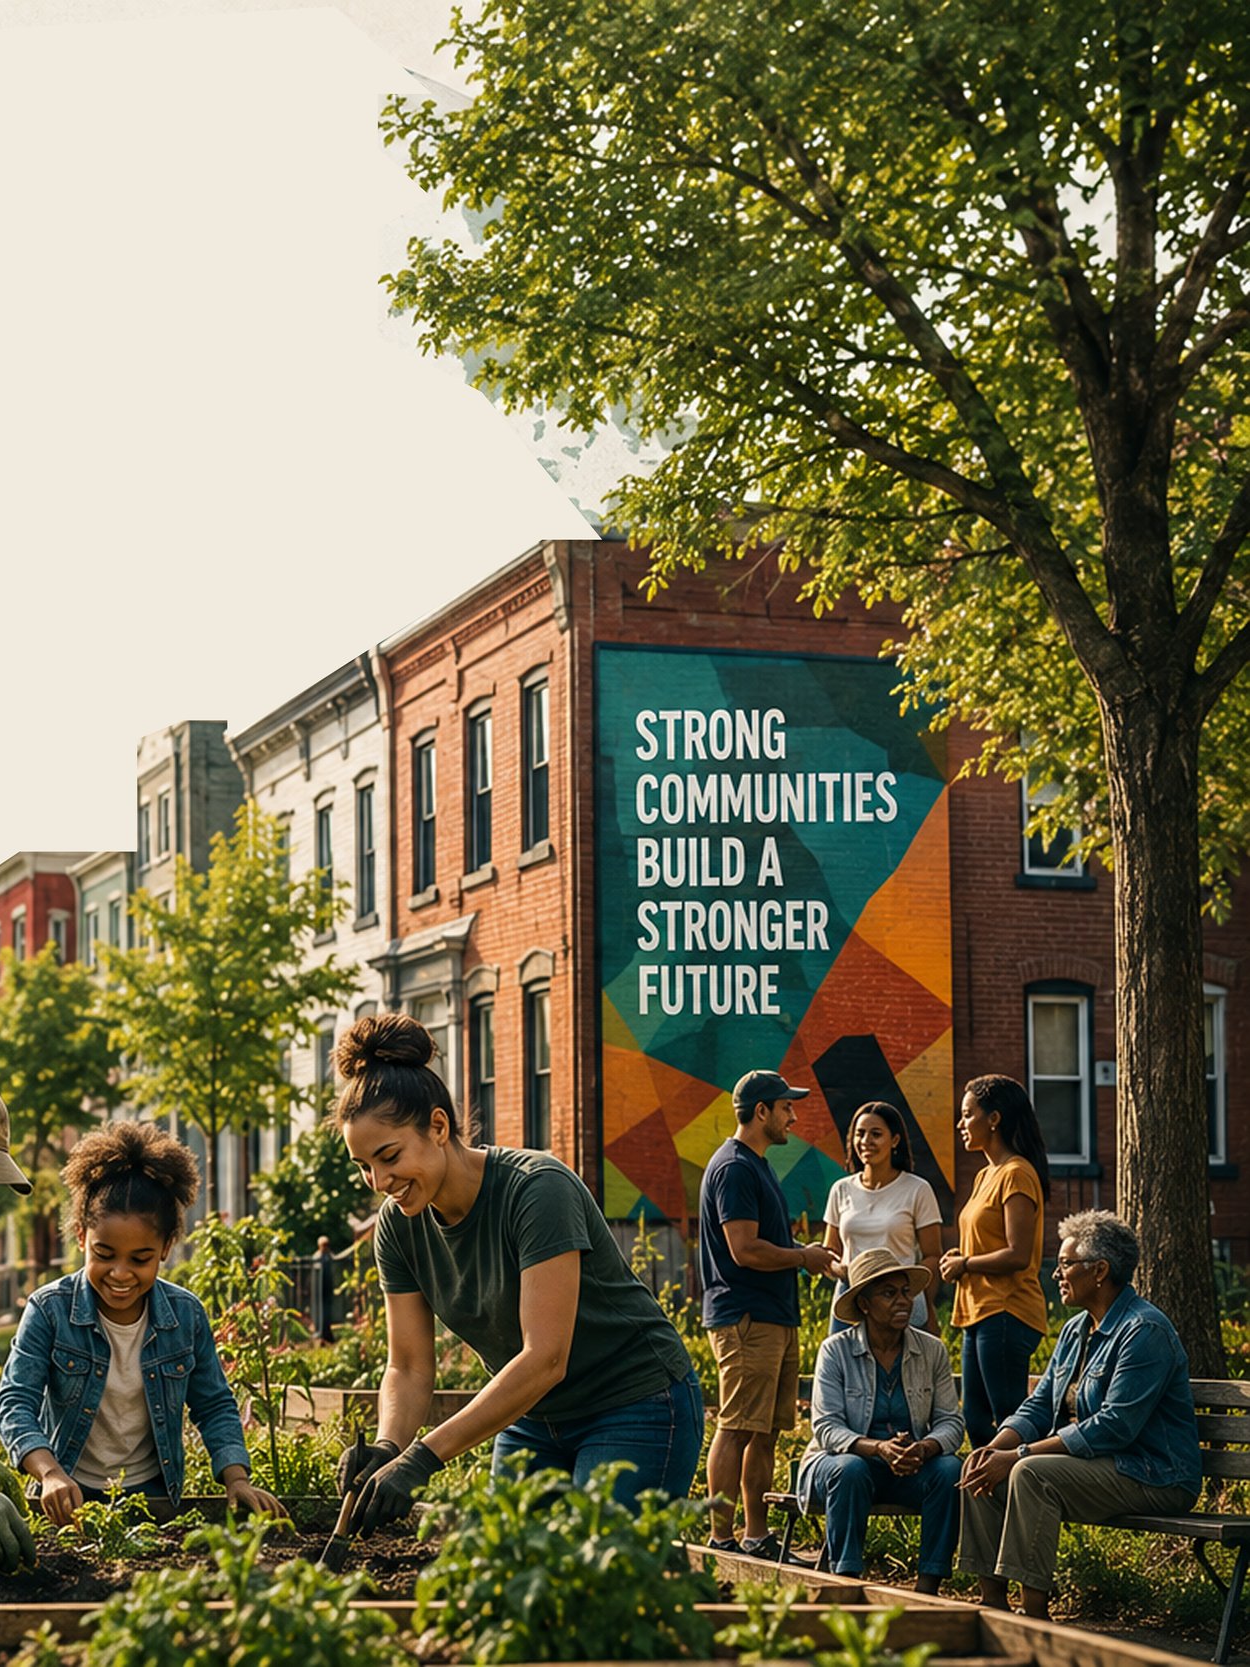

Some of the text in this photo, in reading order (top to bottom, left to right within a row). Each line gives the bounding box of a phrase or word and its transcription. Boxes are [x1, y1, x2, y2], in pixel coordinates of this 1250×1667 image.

[636, 709, 785, 760] STRONG
[636, 772, 897, 824] COMMUNITIES
[638, 837, 783, 887] BUILD A
[638, 900, 829, 951] STRONGER
[639, 965, 780, 1015] FUTURE
